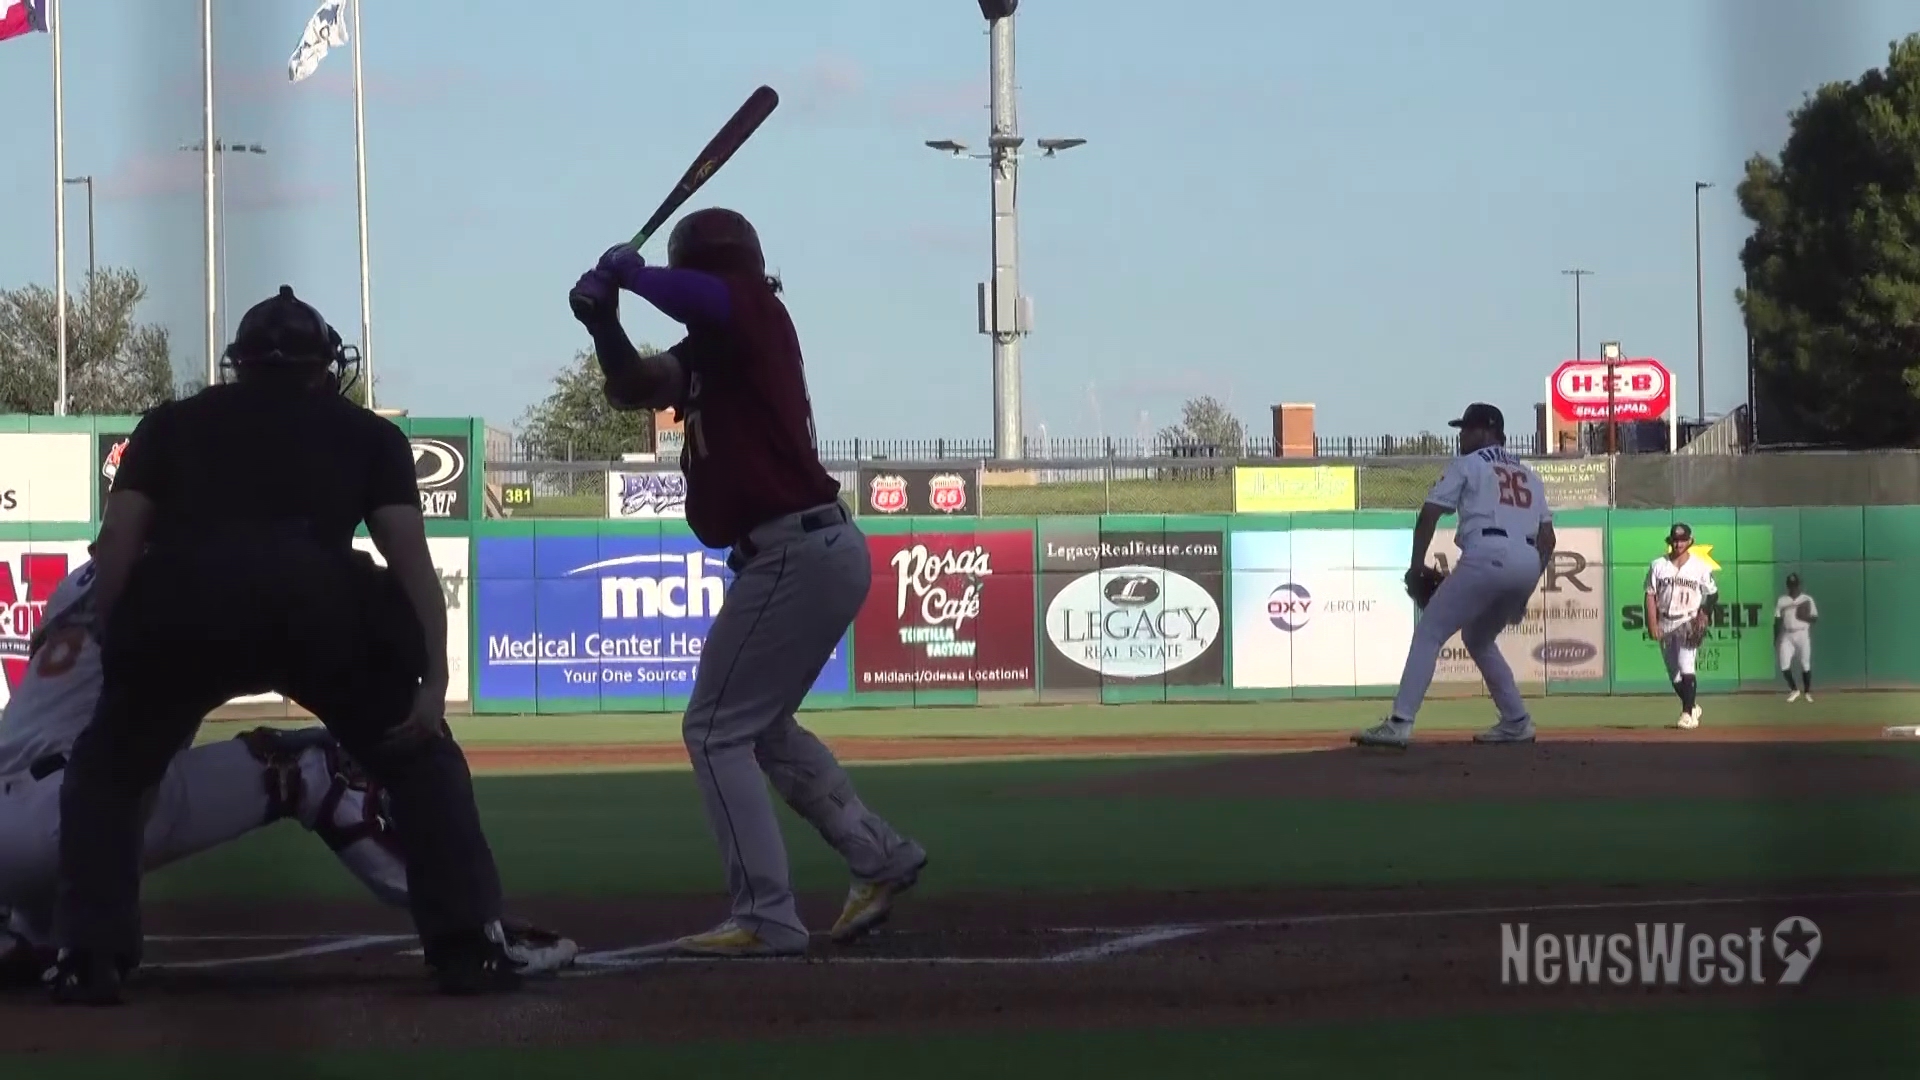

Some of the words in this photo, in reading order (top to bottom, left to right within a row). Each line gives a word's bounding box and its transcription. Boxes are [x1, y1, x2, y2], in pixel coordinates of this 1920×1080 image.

[1575, 404, 1621, 416] SPLAH
[1492, 465, 1532, 509] 26
[505, 488, 532, 504] 381
[877, 491, 901, 506] 66
[936, 489, 959, 505] 66
[1046, 541, 1218, 561] LegacyRealEstate.com
[601, 552, 724, 618] mch
[891, 545, 993, 619] Rosa's
[1267, 600, 1312, 613] OXY
[1679, 592, 1690, 605] 11
[1062, 606, 1208, 643] LEGACY
[489, 632, 576, 659] Medical
[584, 633, 662, 657] Center
[670, 632, 707, 656] He
[1084, 645, 1121, 660] REAL
[1129, 644, 1183, 659] ESTATE
[1540, 645, 1588, 659] Carrier
[563, 668, 597, 683] Your
[602, 668, 632, 682] One
[637, 667, 687, 682] Source
